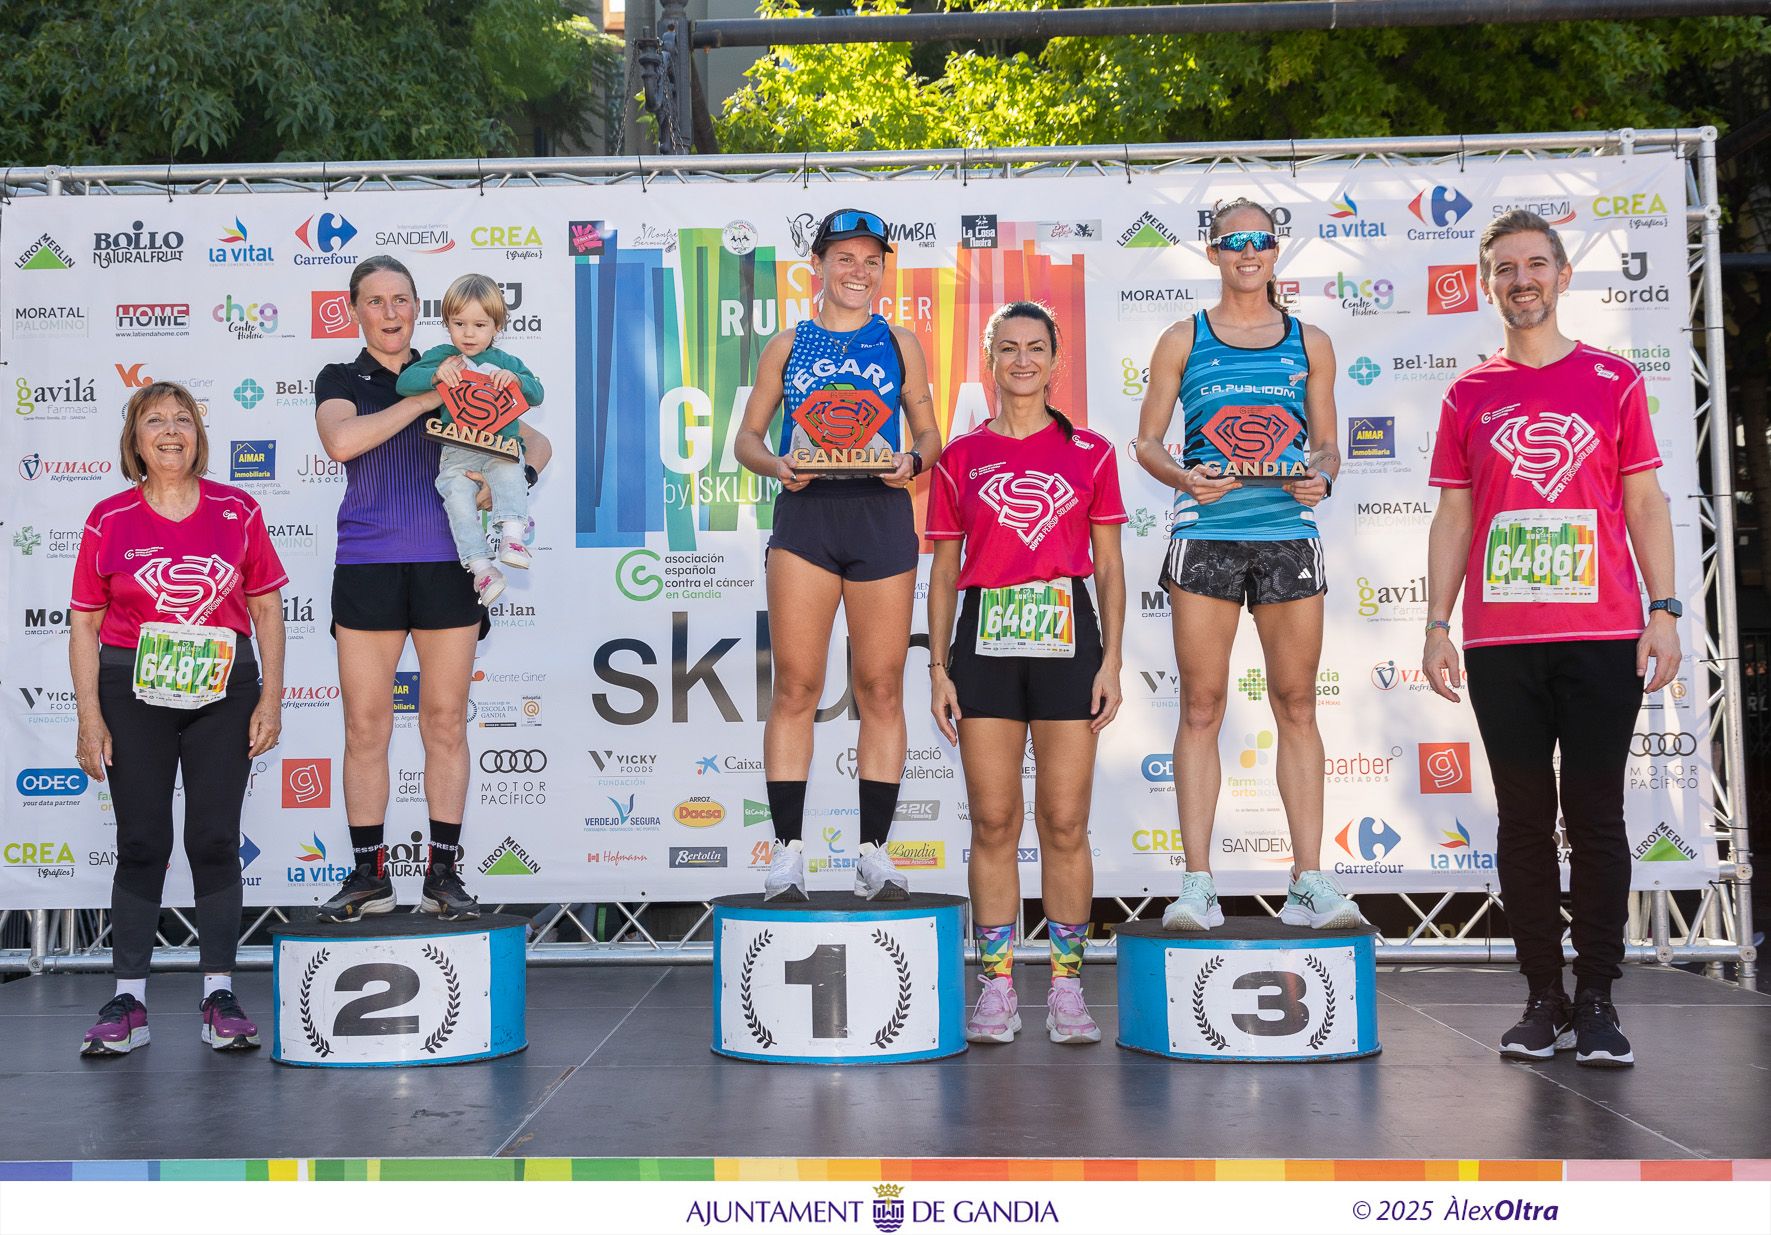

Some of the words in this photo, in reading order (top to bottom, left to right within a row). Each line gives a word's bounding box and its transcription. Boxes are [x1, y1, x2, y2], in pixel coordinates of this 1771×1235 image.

[1593, 193, 1668, 216] CREA
[470, 226, 542, 247] CREA
[887, 222, 936, 242] UMBA
[1117, 216, 1145, 247] LEROY
[1142, 211, 1180, 245] MERLIN
[1319, 224, 1337, 239] la
[1341, 219, 1386, 238] vital
[1407, 228, 1475, 241] Carrefour
[93, 230, 184, 250] BOLLO
[376, 231, 448, 245] SANDEMI
[15, 241, 43, 268] LEROY
[41, 232, 76, 268] MERLIN
[209, 247, 226, 262] la
[231, 244, 274, 262] vital
[294, 253, 358, 266] Carrefour
[1121, 289, 1194, 301] MORATAL
[16, 306, 85, 318] MORATAL
[117, 306, 188, 328] HOME
[1633, 361, 1671, 372] aseo
[16, 376, 97, 415] gavilá
[425, 417, 521, 457] GANDIA
[793, 447, 894, 464] GANDIA
[44, 461, 112, 474] VIMACO
[1206, 459, 1307, 477] GANDIA
[664, 477, 690, 509] by
[699, 476, 783, 503] SKLUM
[1358, 503, 1432, 515] MORATAL
[665, 553, 725, 564] asociación
[1491, 543, 1594, 577] 64867
[665, 565, 716, 578] española
[665, 578, 701, 588] contra
[704, 576, 714, 588] el
[665, 591, 679, 599] en
[682, 588, 722, 599] Gandia
[1356, 576, 1428, 616] gavil
[987, 602, 1070, 634] 64877
[140, 652, 231, 686] 64873
[47, 692, 77, 702] VICK
[280, 686, 340, 700] IMACO
[281, 700, 329, 711] efrigeración
[617, 755, 657, 764] VICKY
[620, 765, 653, 774] FOODS
[1629, 766, 1698, 776] MOTOR
[22, 774, 81, 790] ODEC
[481, 782, 546, 792] MOTOR
[54, 800, 81, 808] partner
[481, 792, 546, 806] PACÍFICO
[679, 806, 722, 819] Dacsa
[585, 817, 619, 826] VERDEJO
[630, 817, 660, 826] SEGURA
[1131, 829, 1185, 851] CRE
[1222, 837, 1293, 853] SANDEM
[1632, 828, 1662, 860] LEROY
[1657, 820, 1698, 860] MERLIN
[2, 842, 76, 864] CREA
[477, 843, 505, 874] LEROY
[503, 835, 541, 874] MERLIN
[604, 850, 648, 866] Hofmann
[891, 842, 936, 859] Bondia
[1334, 861, 1404, 875] Carrefour
[1430, 853, 1453, 870] la
[287, 867, 305, 882] la
[784, 943, 848, 1039] 1
[332, 963, 421, 1037] 2
[1231, 970, 1310, 1037] 3
